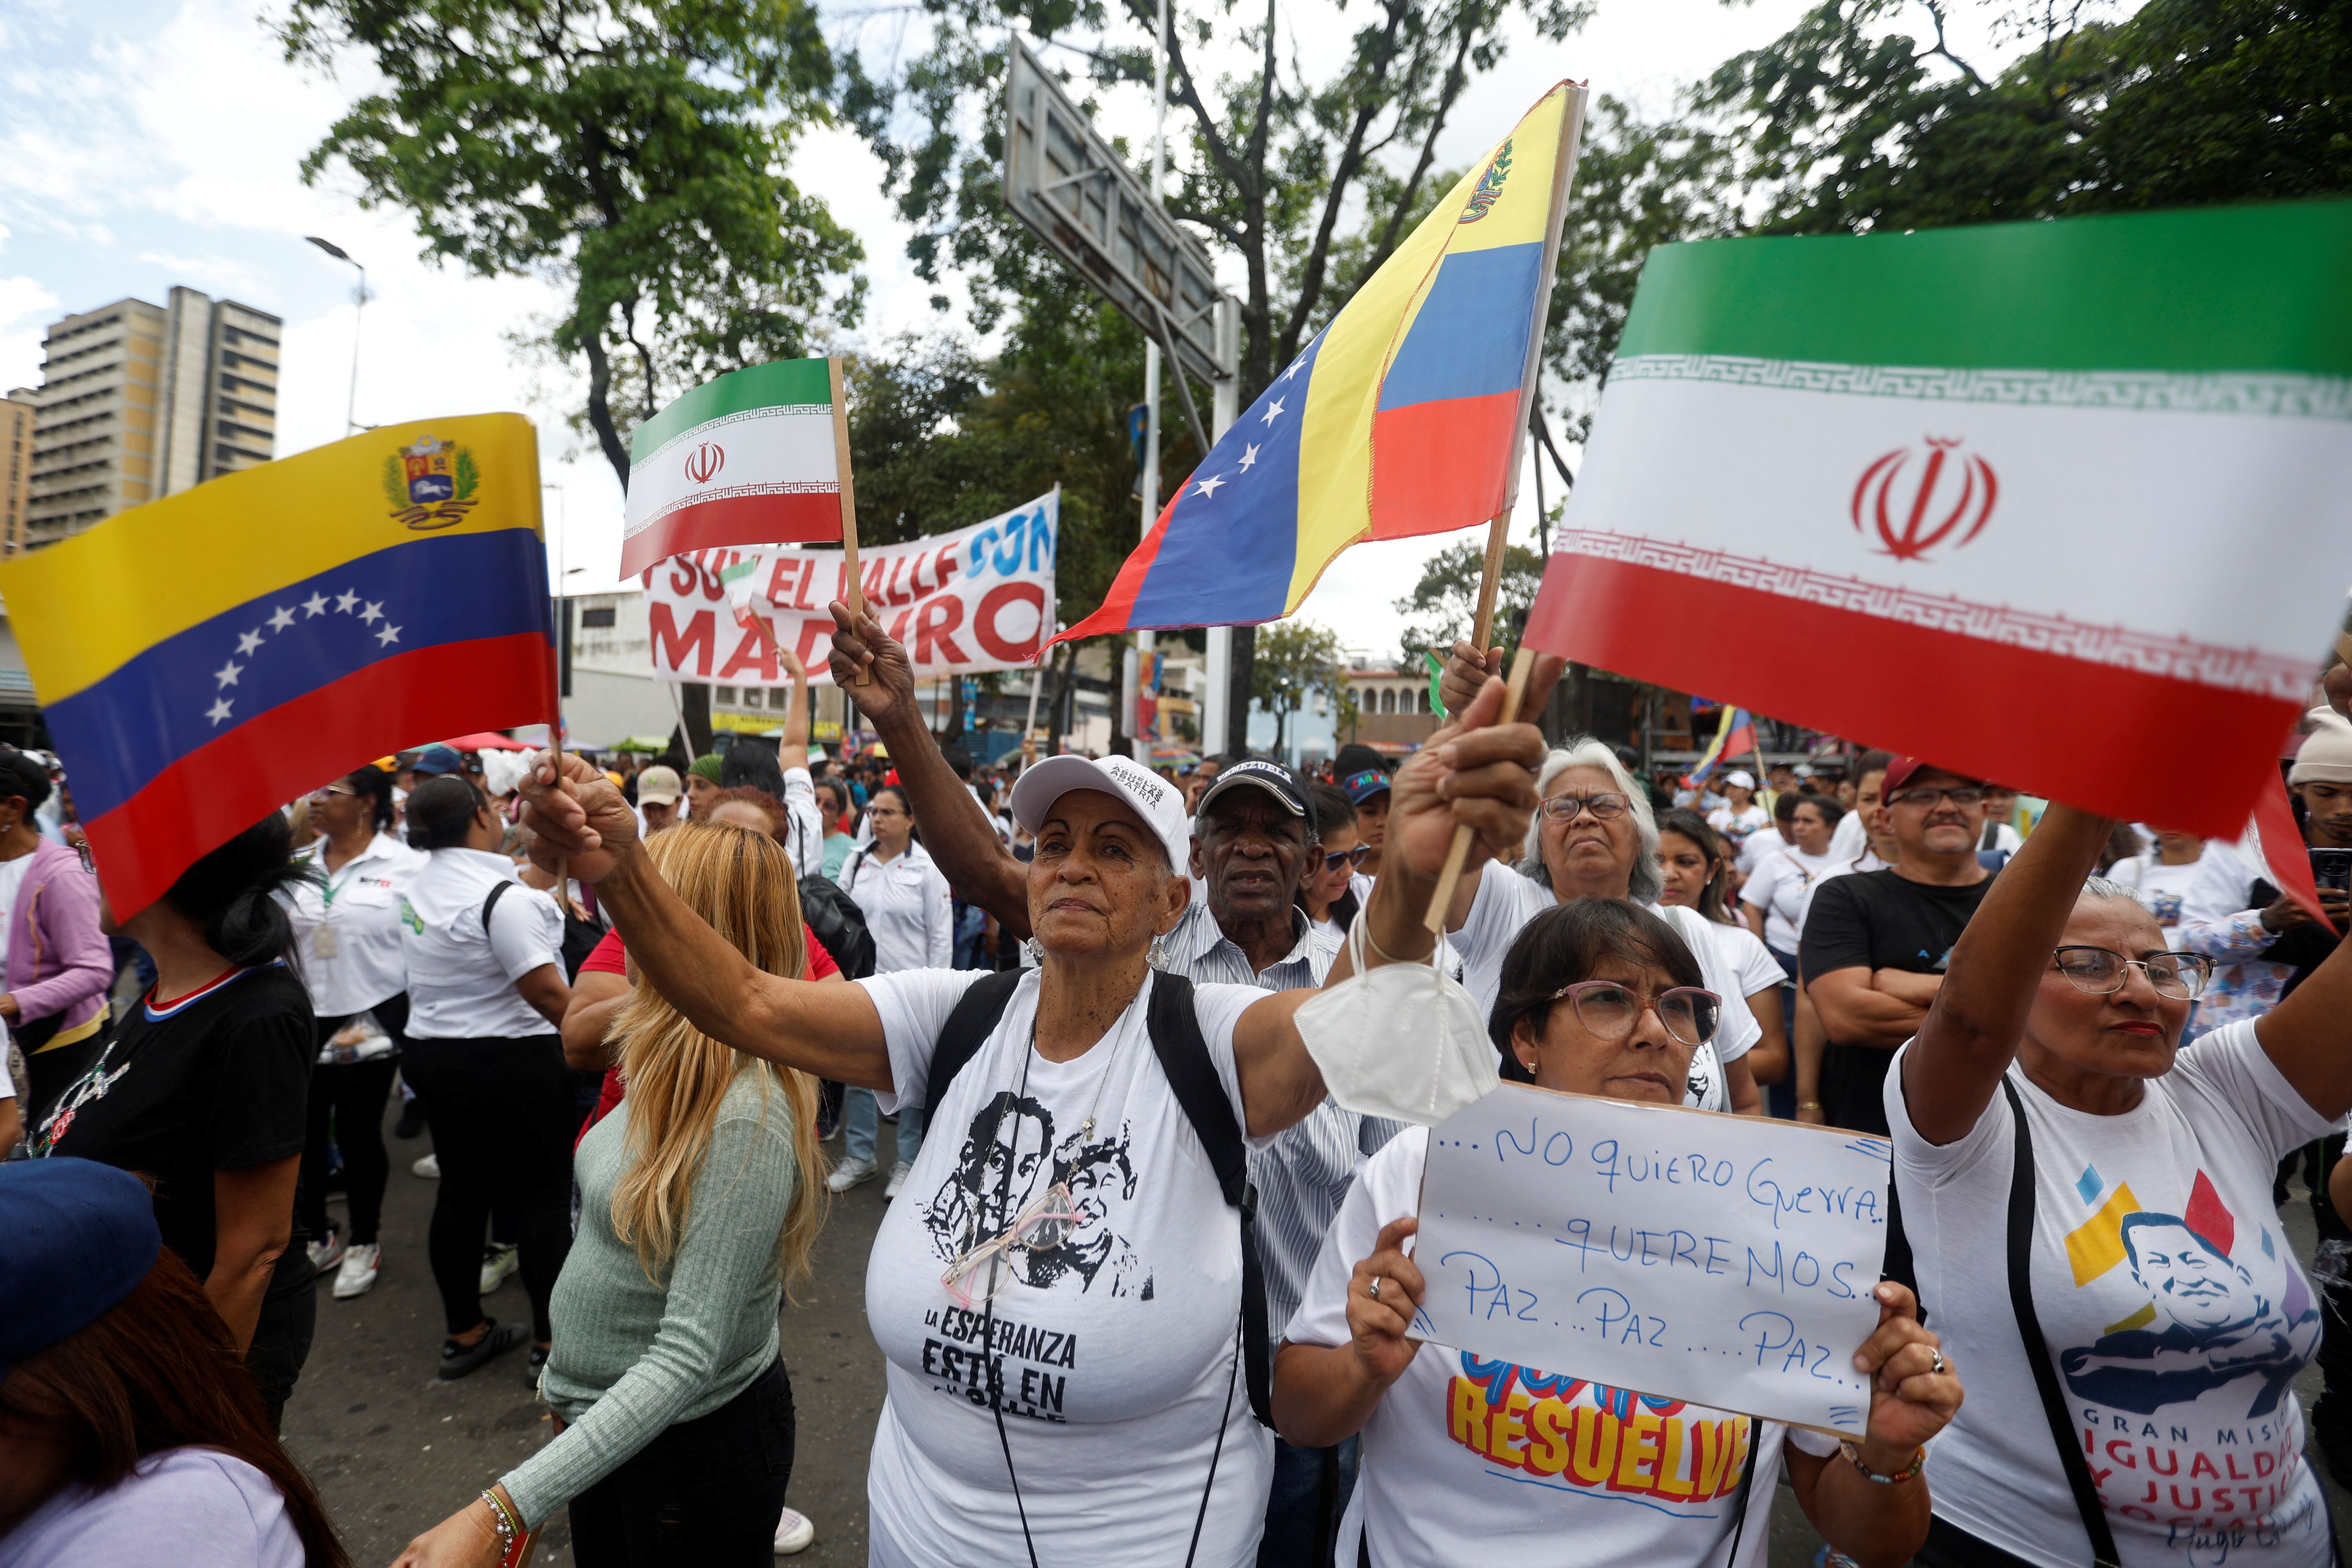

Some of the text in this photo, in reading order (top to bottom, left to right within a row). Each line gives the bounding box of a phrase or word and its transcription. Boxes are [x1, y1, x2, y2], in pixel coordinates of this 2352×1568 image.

[642, 549, 762, 602] SU
[767, 558, 815, 610] EL
[966, 502, 1058, 579] CON
[1113, 766, 1164, 796] ABUELOS
[1115, 763, 1135, 774] GRAN
[1217, 761, 1293, 785] VENEZUELA
[1110, 770, 1161, 803] ABUELAS
[1117, 777, 1156, 810] PATRIA
[924, 1309, 938, 1328] LA
[940, 1305, 1077, 1369] ESPERANZA
[922, 1338, 1007, 1396] ESTÁ
[1021, 1368, 1066, 1412] EN
[1447, 1375, 1752, 1504] RESUELVE
[2083, 1408, 2188, 1443] GRAN
[2084, 1426, 2292, 1480] IGUALDAD
[2087, 1461, 2113, 1488] Y
